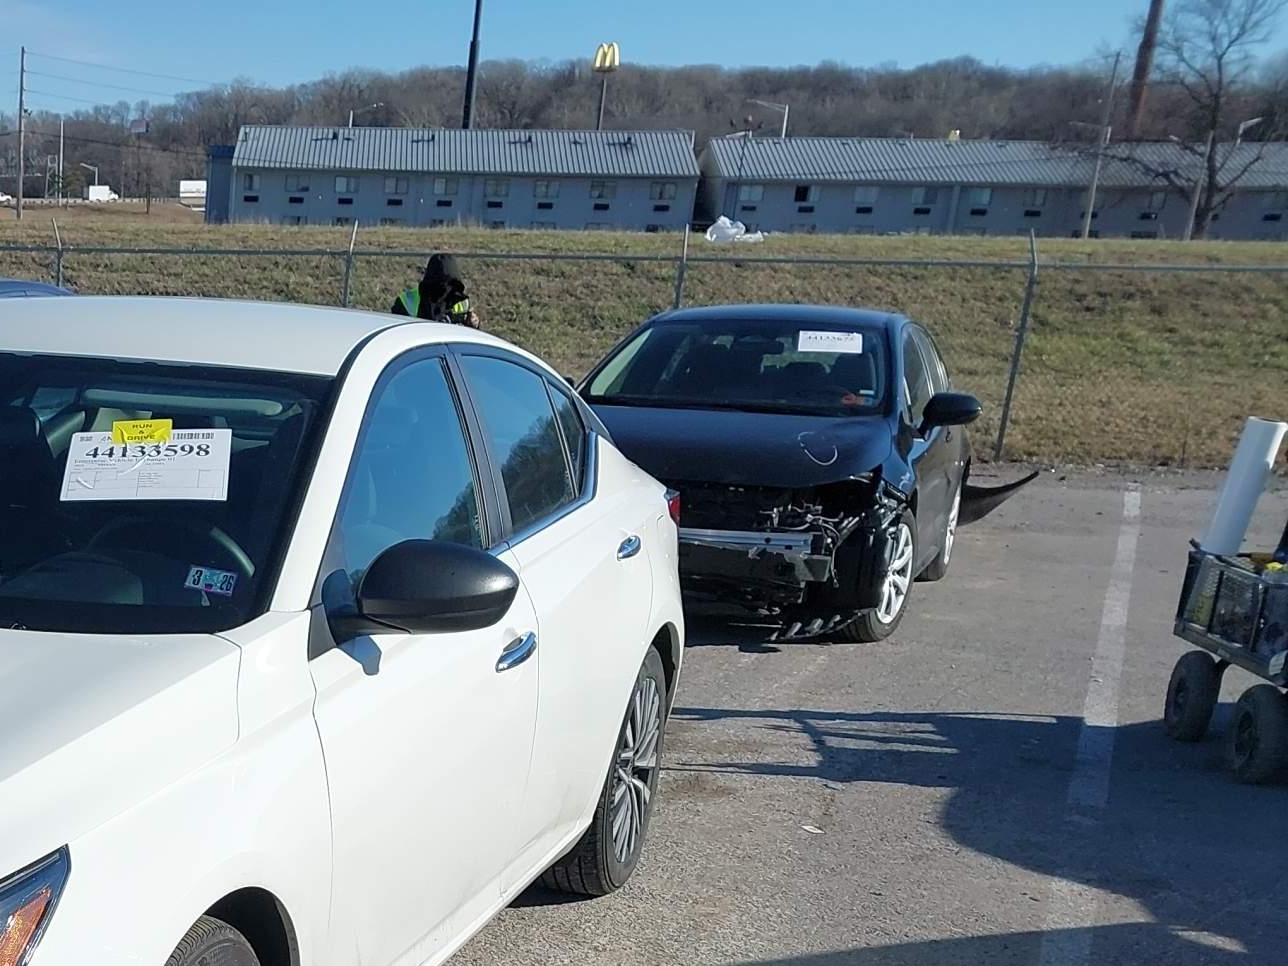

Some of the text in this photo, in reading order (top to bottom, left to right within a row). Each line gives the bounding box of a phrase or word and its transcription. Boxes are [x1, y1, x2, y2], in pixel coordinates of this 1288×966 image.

[85, 443, 210, 459] 44133598
[192, 569, 235, 592] 3 26
